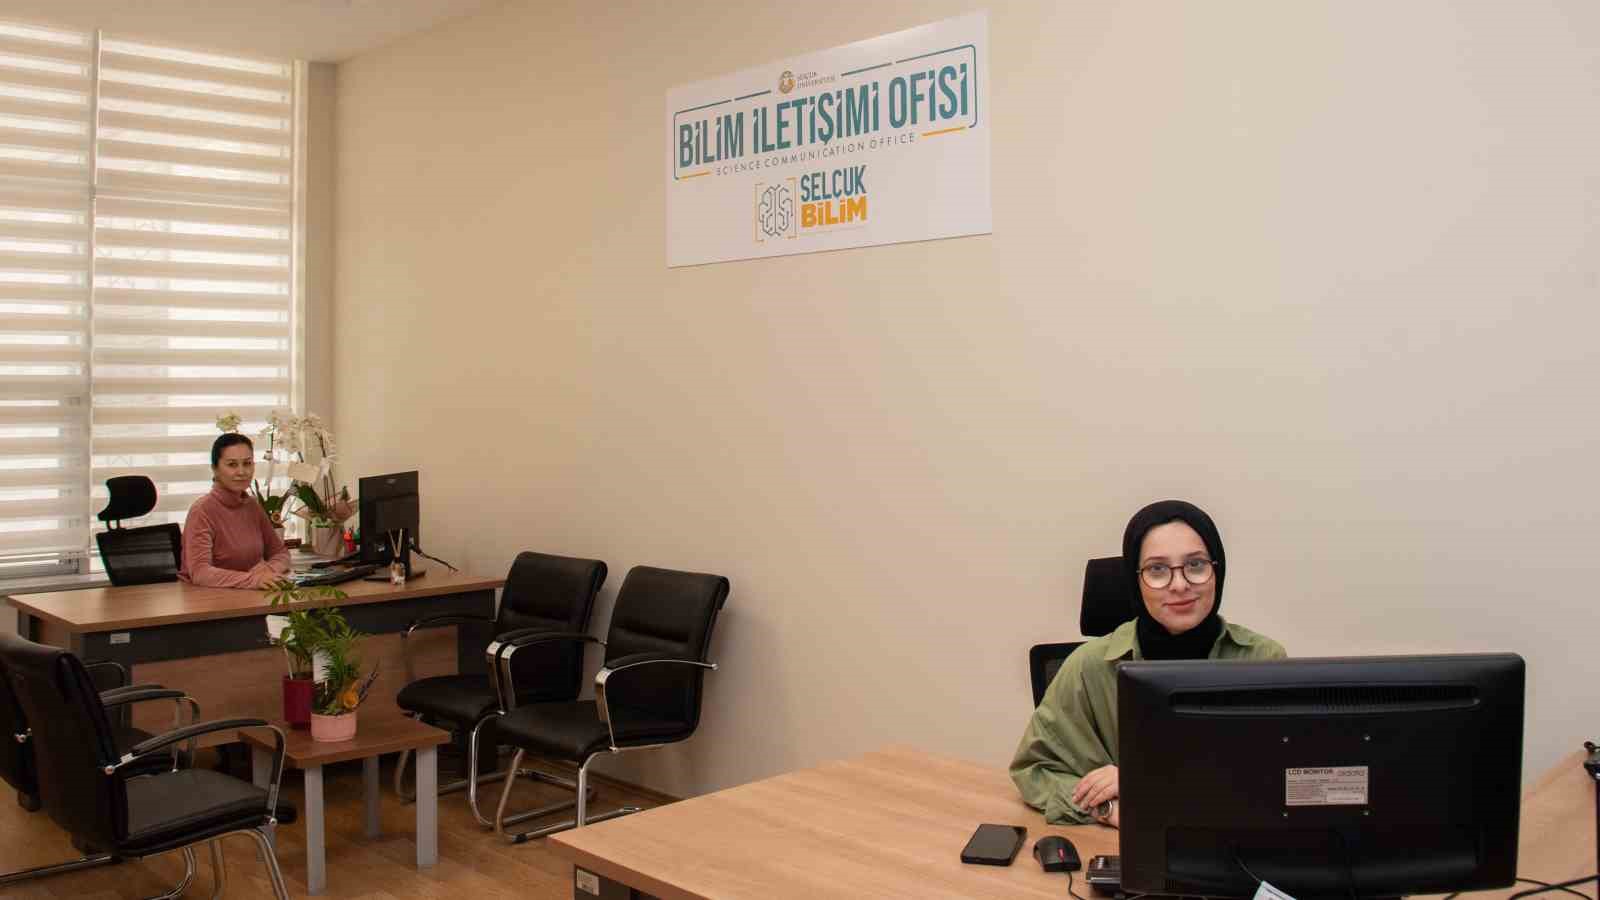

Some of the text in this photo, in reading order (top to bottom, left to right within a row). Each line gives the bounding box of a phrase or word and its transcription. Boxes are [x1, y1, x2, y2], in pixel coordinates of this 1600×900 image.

[679, 63, 968, 168] BİLİM İLETİŞİMİ OFİSİ
[716, 132, 915, 176] SCIENCE COMMUNICATION OFFICE
[801, 195, 867, 228] BİLİM
[1287, 768, 1302, 776] LCD
[1303, 767, 1334, 776] MONITOR
